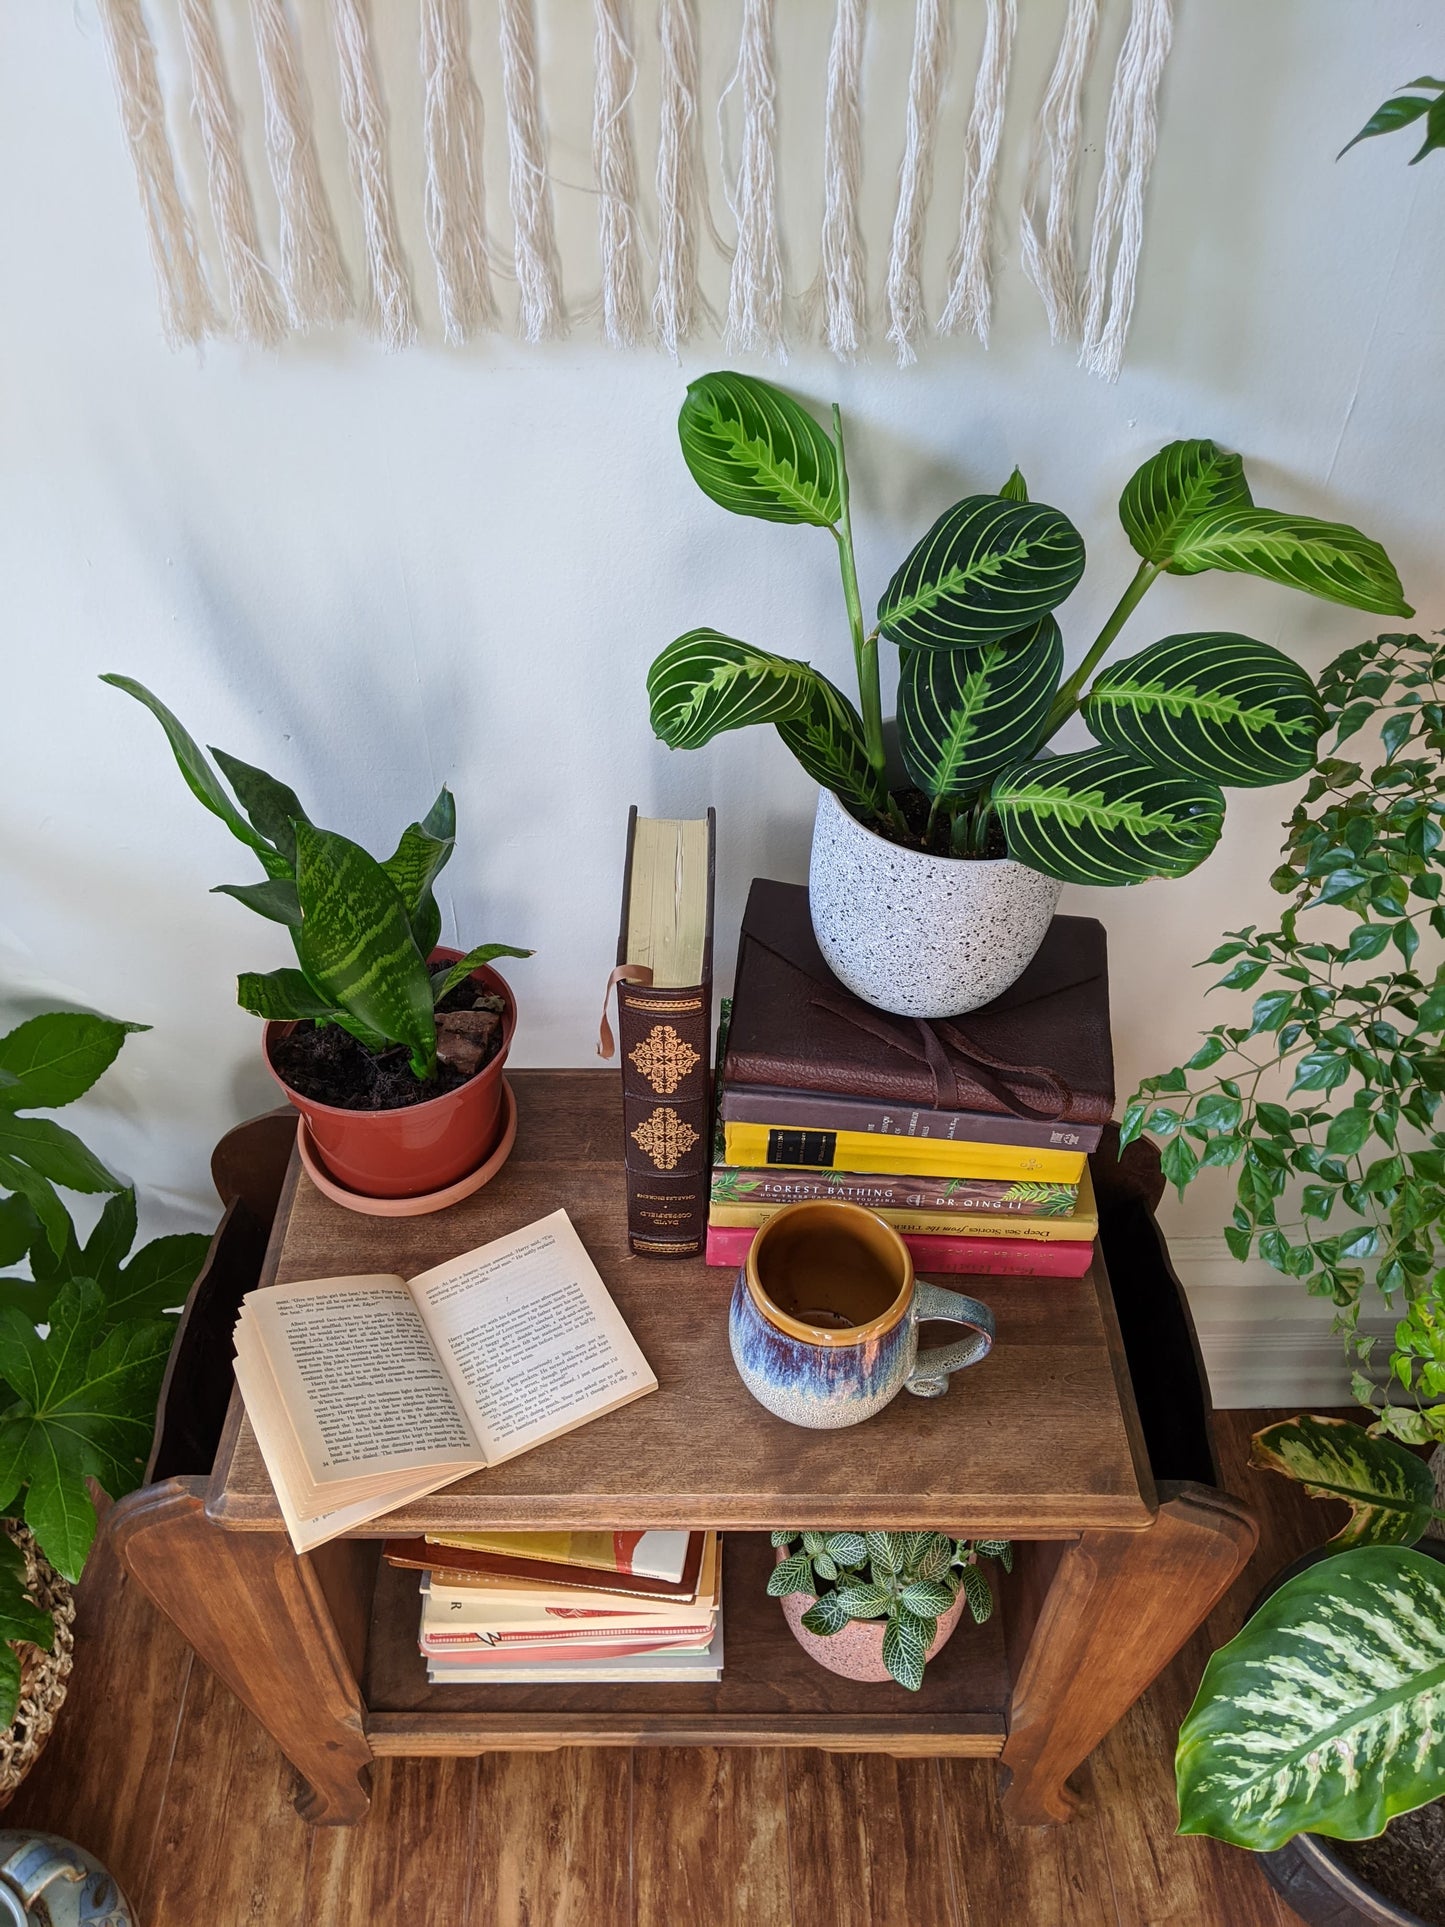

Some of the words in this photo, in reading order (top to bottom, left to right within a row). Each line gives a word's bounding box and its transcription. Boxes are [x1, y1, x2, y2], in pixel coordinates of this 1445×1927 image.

[764, 1184, 819, 1195] FOREST
[827, 1186, 894, 1197] BATHING
[636, 1193, 666, 1201] DICKENS
[935, 1198, 959, 1207] DR.
[963, 1199, 1002, 1209] QING
[1008, 1202, 1022, 1210] LI
[639, 1210, 692, 1219] COPPERFIELD
[652, 1218, 680, 1226] DAVID
[942, 1225, 968, 1234] from
[968, 1227, 1001, 1236] Stories
[1024, 1228, 1050, 1237] Deep
[450, 1601, 462, 1610] R
